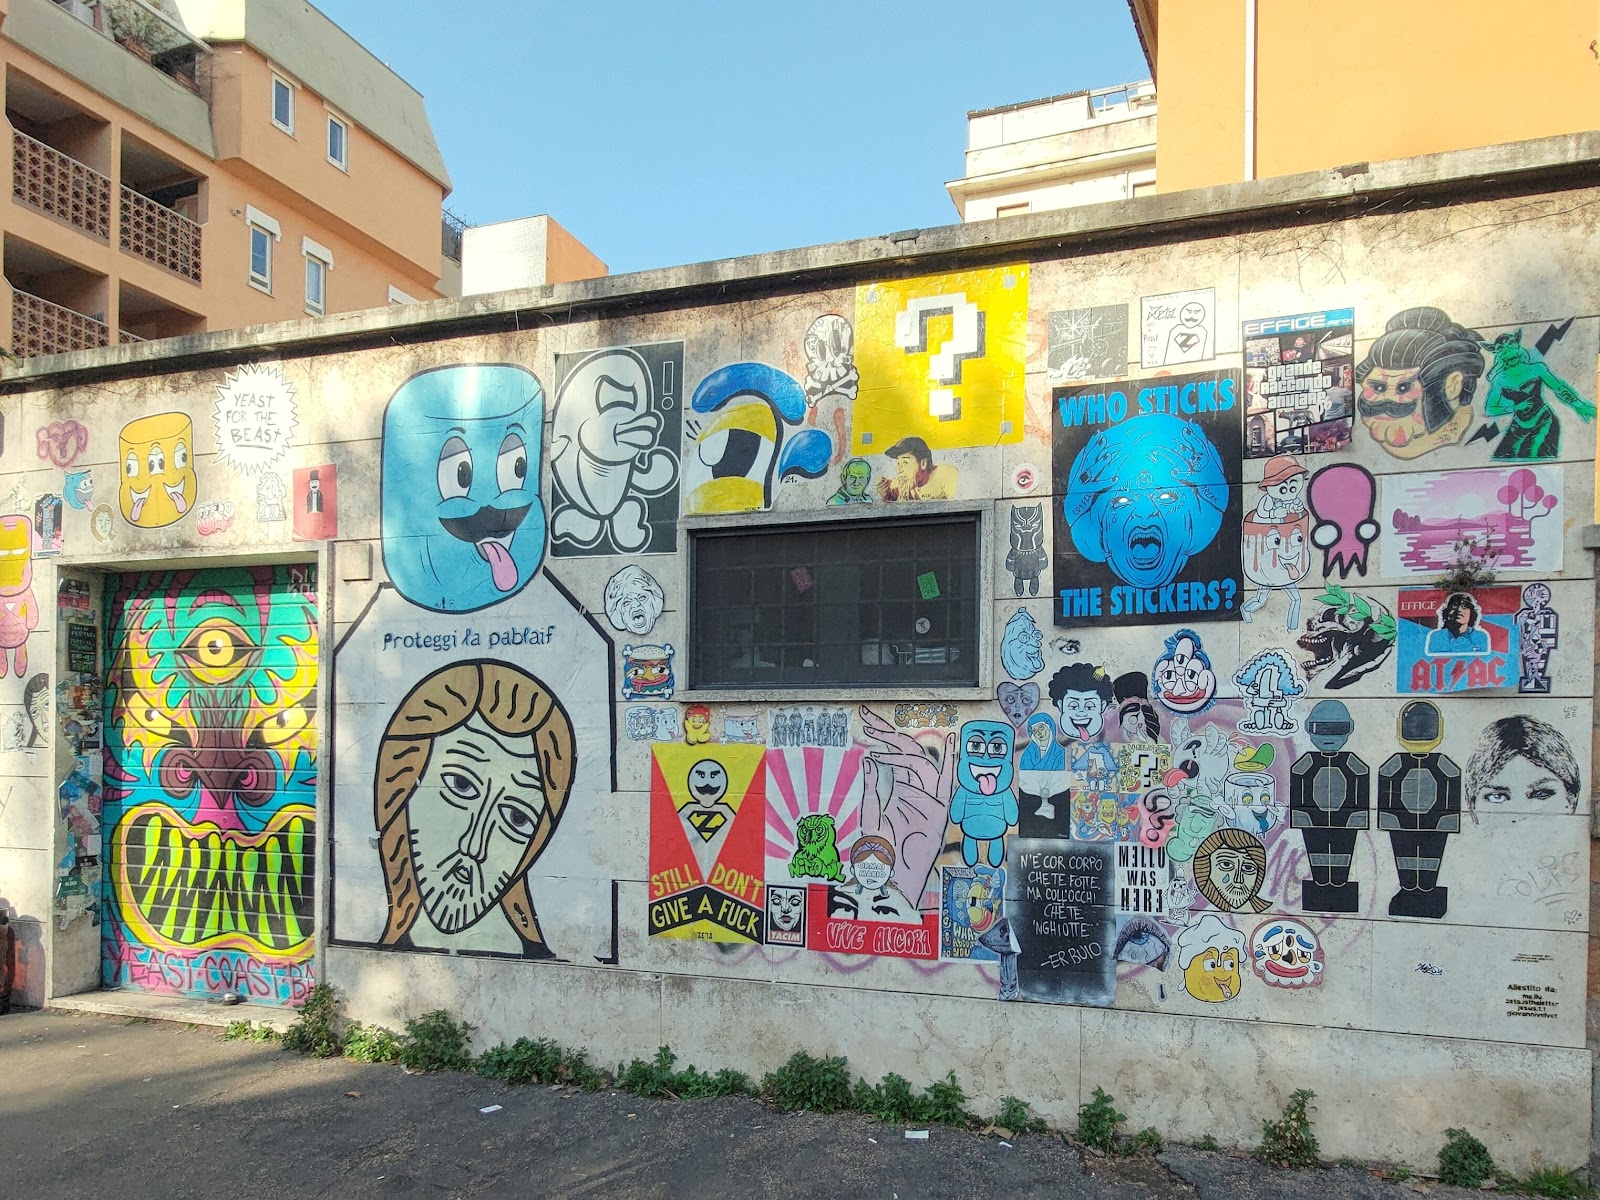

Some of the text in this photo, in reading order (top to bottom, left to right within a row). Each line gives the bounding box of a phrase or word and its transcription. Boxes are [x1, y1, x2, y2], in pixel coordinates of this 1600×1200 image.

[1245, 315, 1326, 335] EFFIGE
[234, 393, 275, 408] YEAST
[1059, 378, 1235, 428] WHO STICKS
[226, 410, 278, 425] FOR THE
[231, 426, 281, 443] BEAST
[1060, 577, 1237, 618] THE STICKERS?
[1401, 601, 1437, 610] EFFIGE
[383, 631, 458, 651] Proteggi
[462, 628, 481, 647] la
[857, 862, 886, 870] ORMAI
[1043, 855, 1066, 870] COR
[1069, 856, 1103, 871] CORPO
[651, 862, 764, 903] STILL DON'T
[859, 870, 887, 879] MARIO
[1127, 871, 1156, 887] WAS
[1027, 886, 1042, 900] MA
[651, 893, 760, 937] GIVE A FUCK
[770, 931, 801, 941] TACIM
[873, 926, 932, 956] ANCORA
[953, 948, 971, 957] YOU
[1068, 942, 1102, 964] BUIO
[204, 956, 283, 999] COAST
[1507, 984, 1541, 992] Allestito
